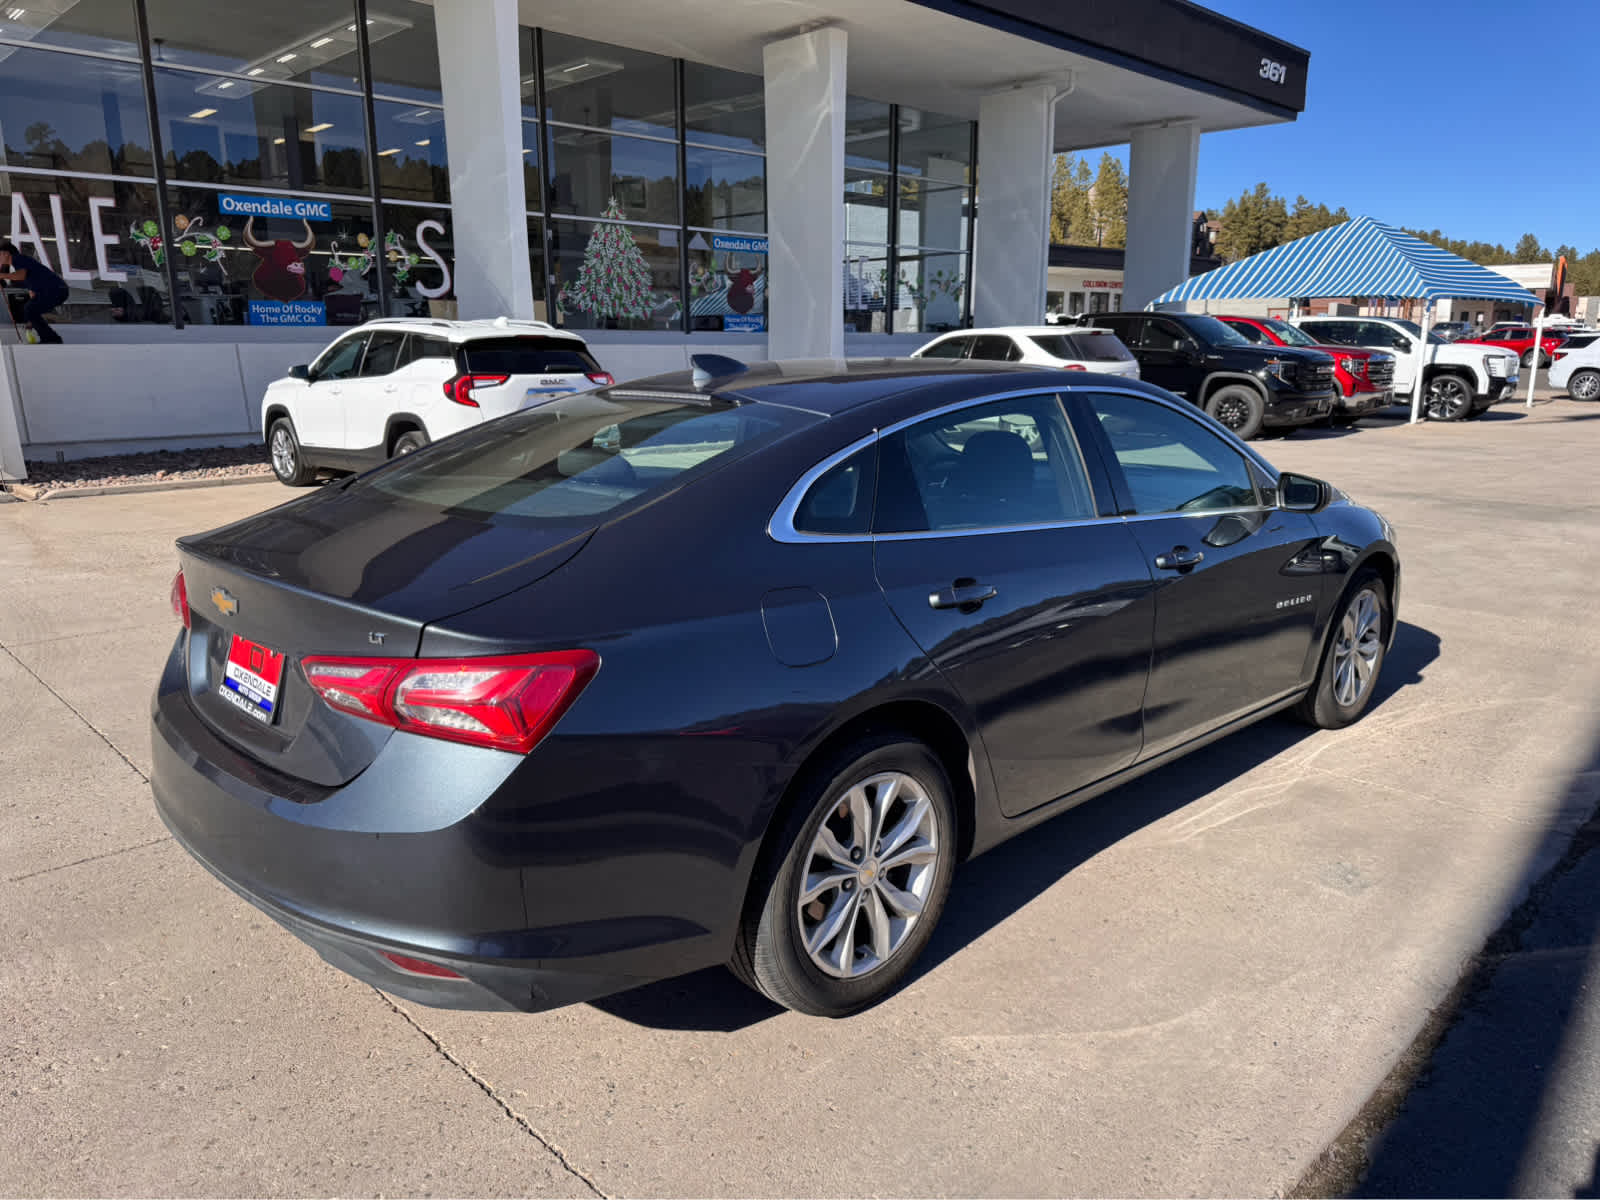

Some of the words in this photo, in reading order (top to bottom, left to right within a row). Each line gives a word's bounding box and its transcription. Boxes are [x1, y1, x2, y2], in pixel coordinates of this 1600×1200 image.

[1259, 57, 1287, 84] 361
[222, 197, 293, 215] Oxendale
[294, 203, 329, 217] GMC
[252, 304, 280, 313] Home
[282, 304, 293, 313] Of
[294, 304, 322, 315] Rocky
[260, 313, 279, 323] The
[280, 314, 302, 323] GMC
[303, 314, 317, 323] Ox
[368, 631, 388, 646] LT
[233, 666, 272, 697] OXENDALE
[218, 685, 267, 722] OXENDALE.com
